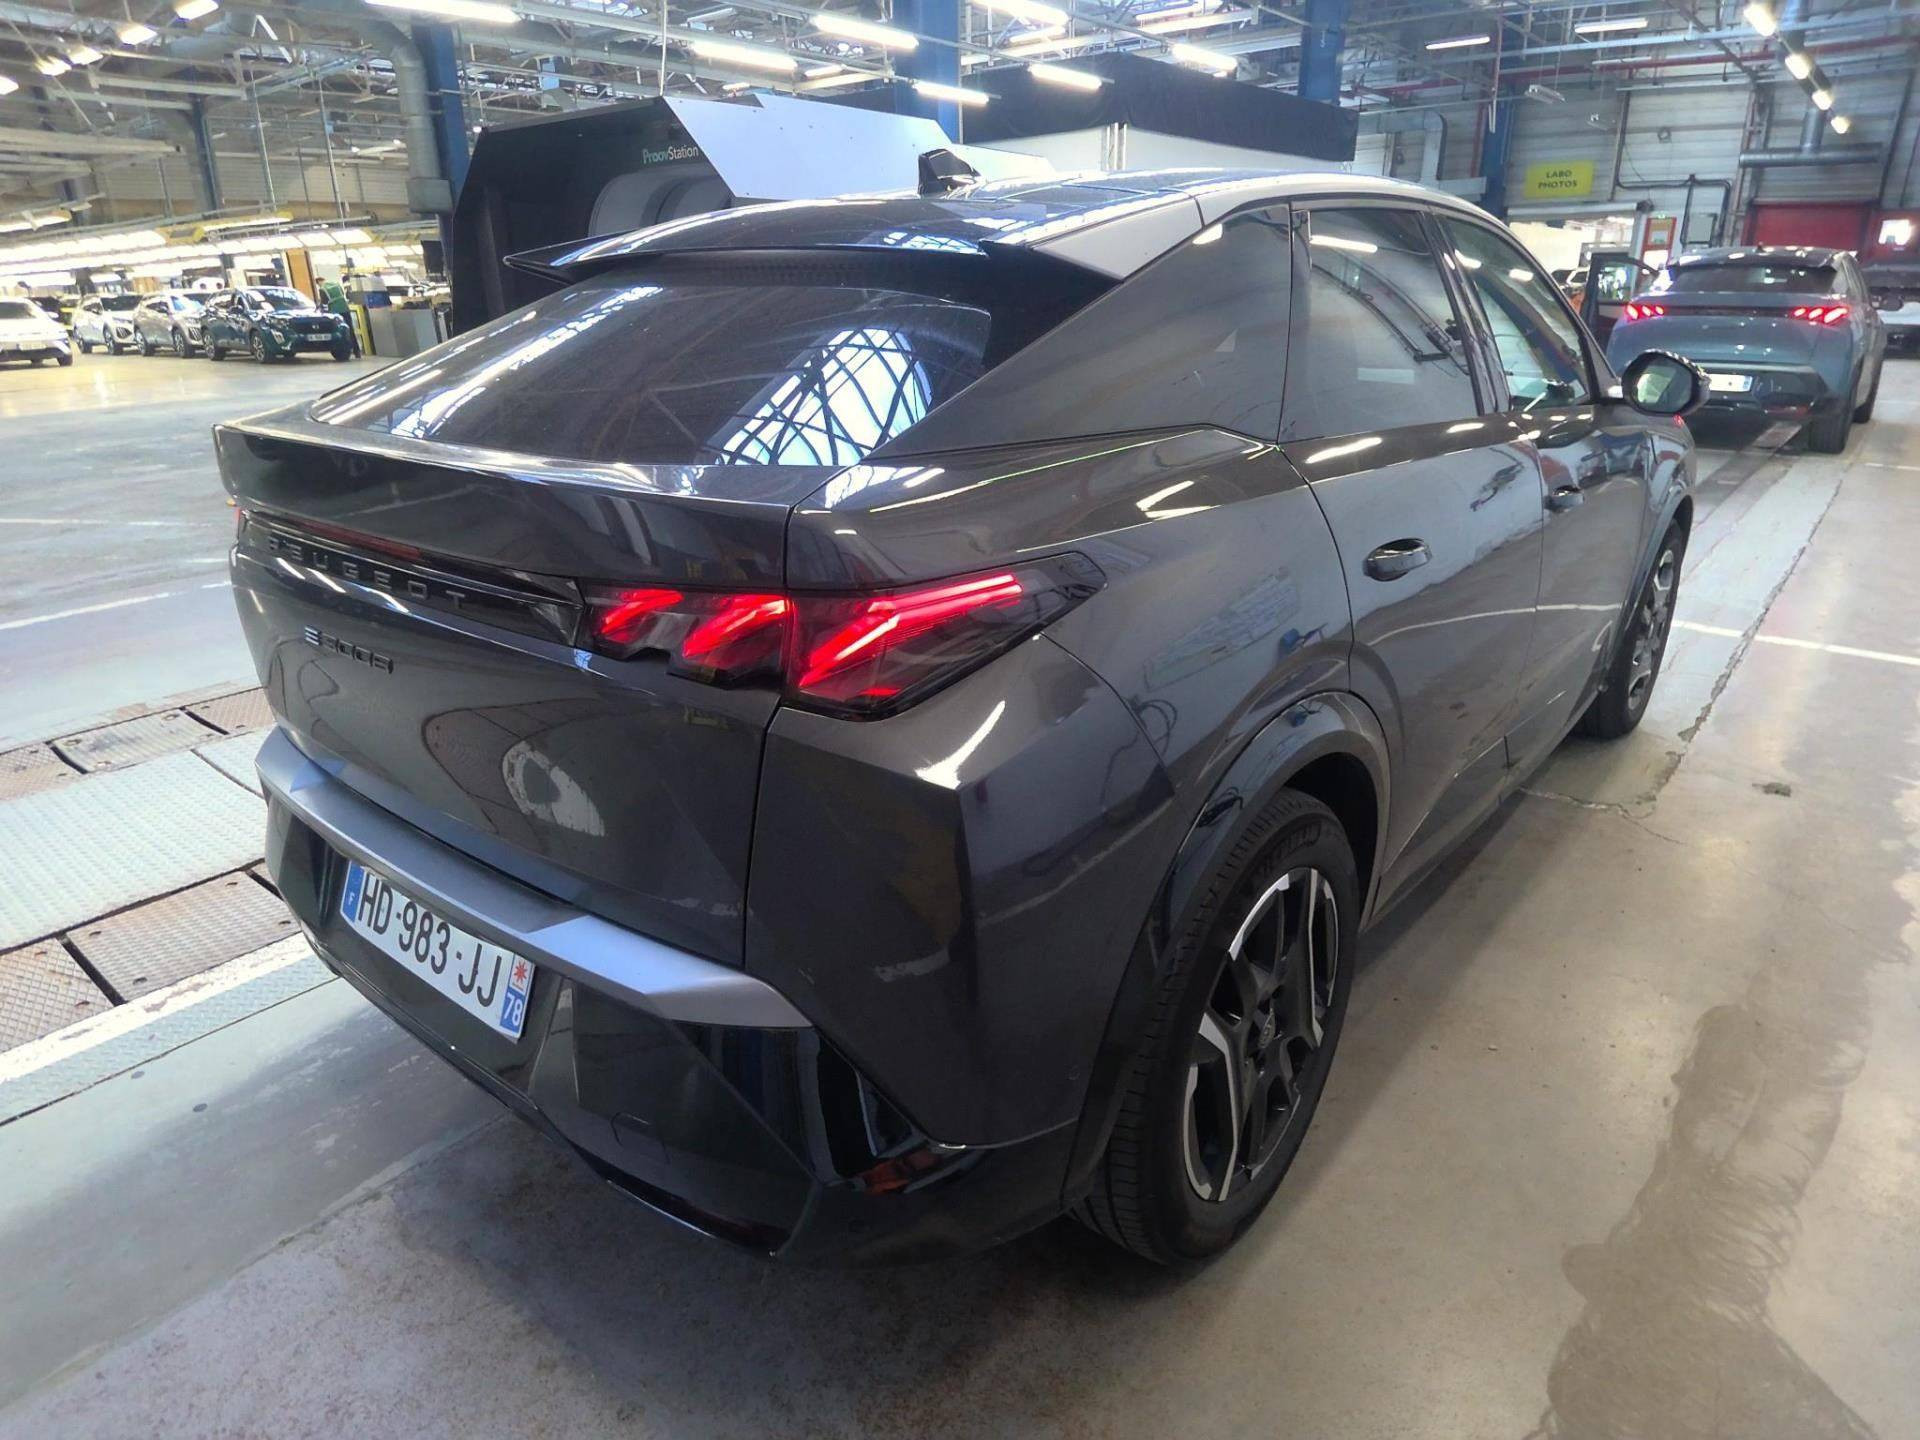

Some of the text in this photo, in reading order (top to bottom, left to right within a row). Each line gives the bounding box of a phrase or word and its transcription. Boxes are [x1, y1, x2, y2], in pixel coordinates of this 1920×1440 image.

[642, 145, 699, 164] ProovStation
[1545, 169, 1573, 179] LABO
[1537, 179, 1578, 189] PHOTOS
[267, 536, 466, 609] PEUGEOT
[504, 991, 523, 1027] 78
